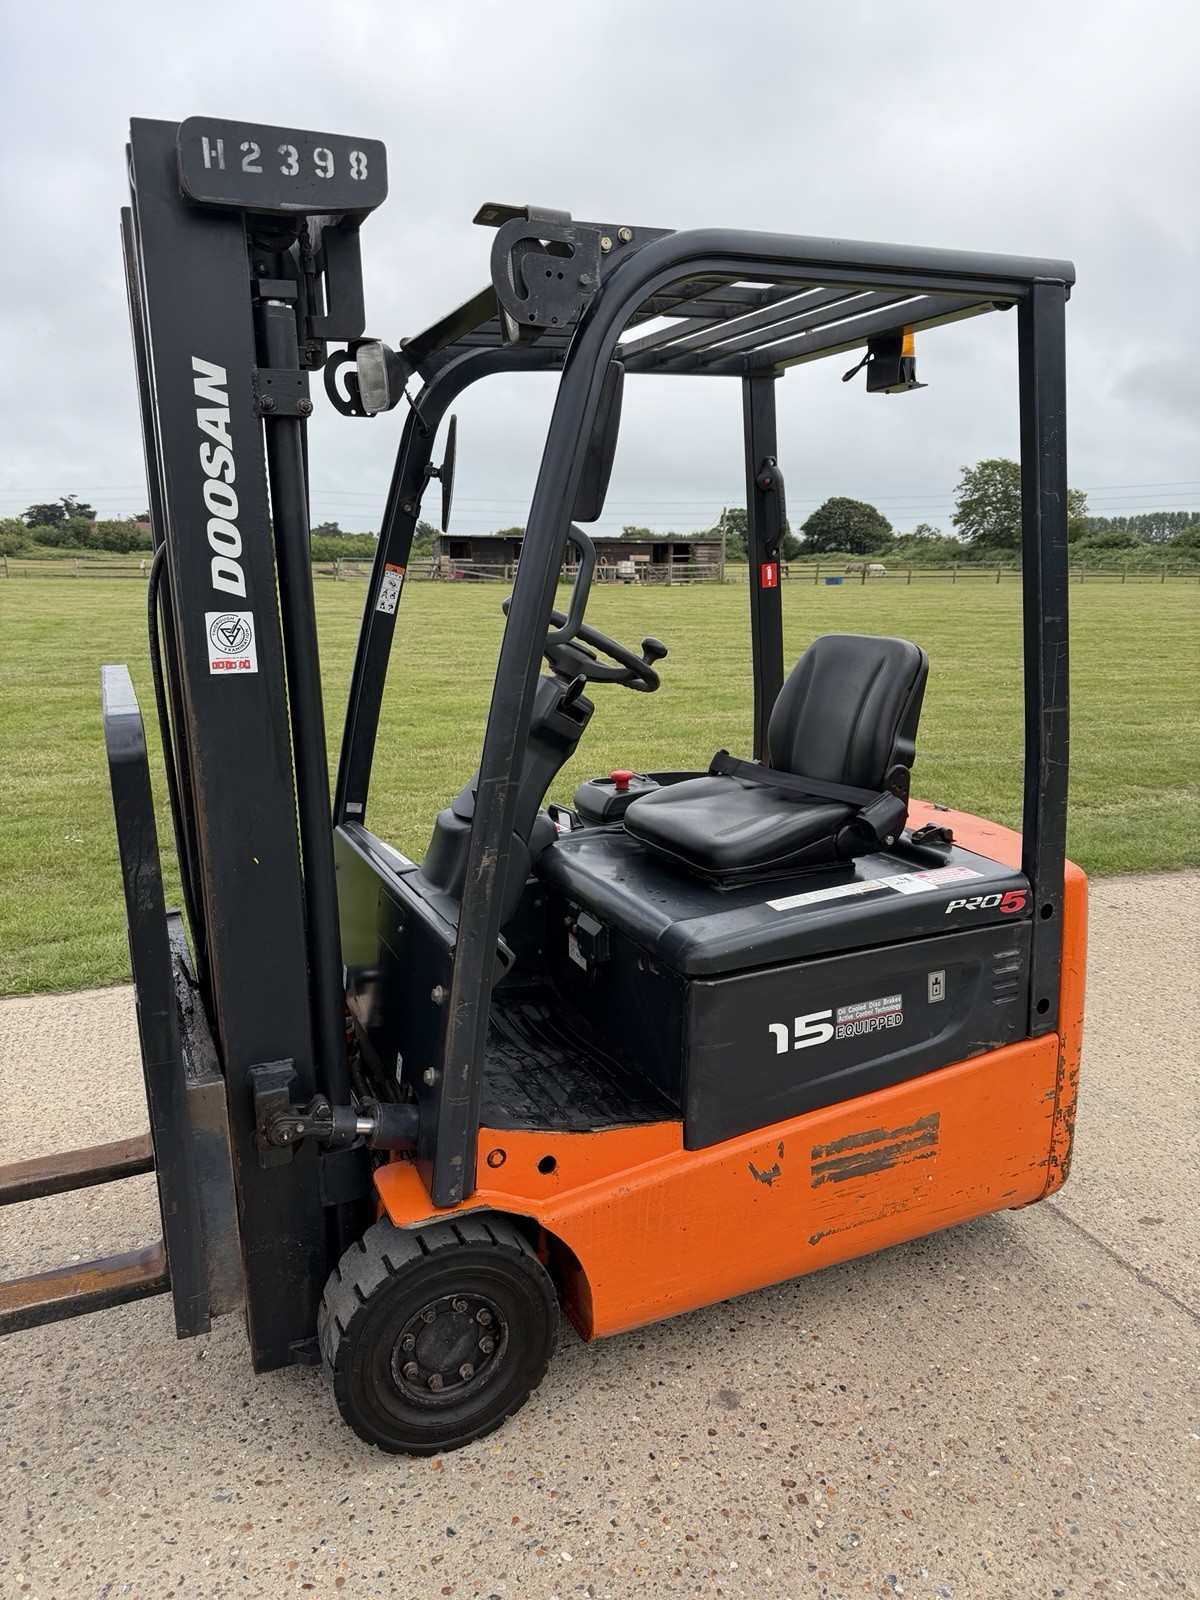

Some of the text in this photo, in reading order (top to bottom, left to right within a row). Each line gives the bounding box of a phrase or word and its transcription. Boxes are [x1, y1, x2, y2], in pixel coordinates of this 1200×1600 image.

[192, 356, 247, 598] DOOSAN
[212, 616, 235, 636] THOROUGH
[224, 628, 250, 652] EXAMINATION
[837, 996, 902, 1016] Oil Cooled Disc Brakes
[838, 1003, 902, 1022] Active Control Technology
[769, 1009, 834, 1054] 15
[836, 1013, 904, 1039] EQUIPPED
